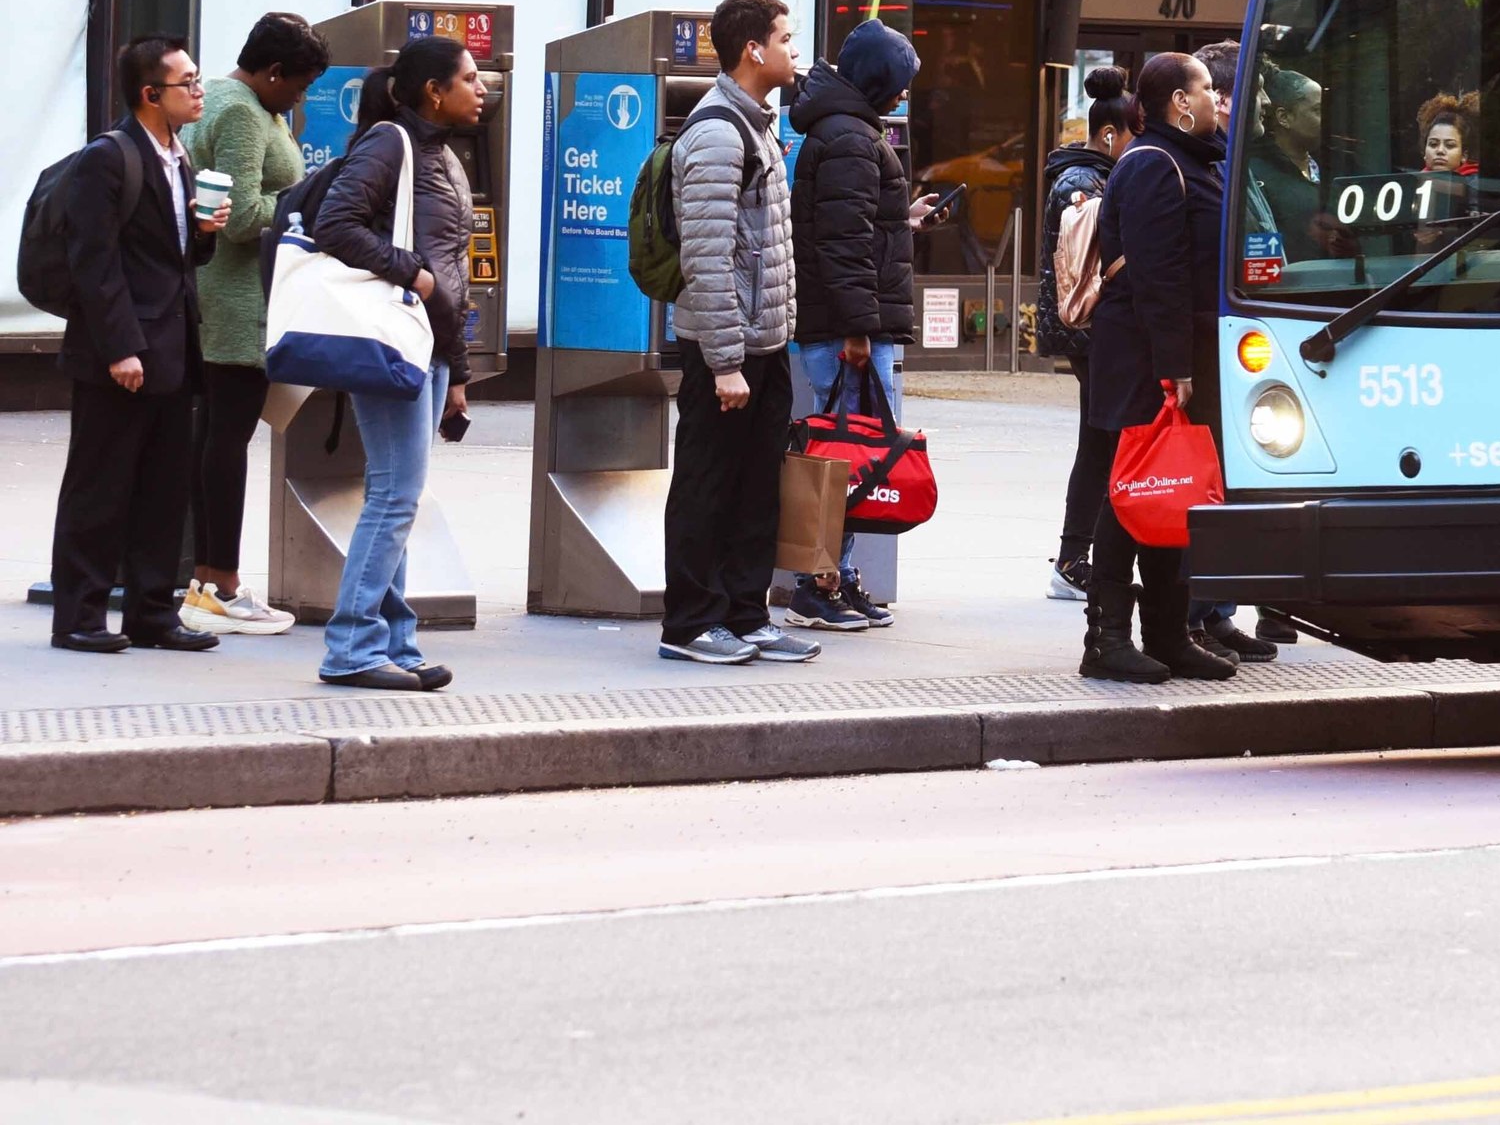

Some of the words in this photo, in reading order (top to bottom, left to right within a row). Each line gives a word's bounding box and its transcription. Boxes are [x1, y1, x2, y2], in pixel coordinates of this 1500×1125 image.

[409, 16, 416, 28] 1
[436, 16, 444, 28] 2
[468, 17, 476, 29] 3
[676, 24, 681, 36] 1
[698, 25, 705, 37] 2
[302, 143, 332, 165] Get
[564, 147, 599, 168] Get
[563, 173, 622, 195] Ticket
[563, 199, 607, 221] Here
[472, 213, 490, 221] METRO
[561, 226, 581, 235] Before
[583, 227, 595, 235] You
[596, 228, 614, 236] Board
[615, 229, 627, 237] Bus
[1360, 363, 1444, 408] 5513
